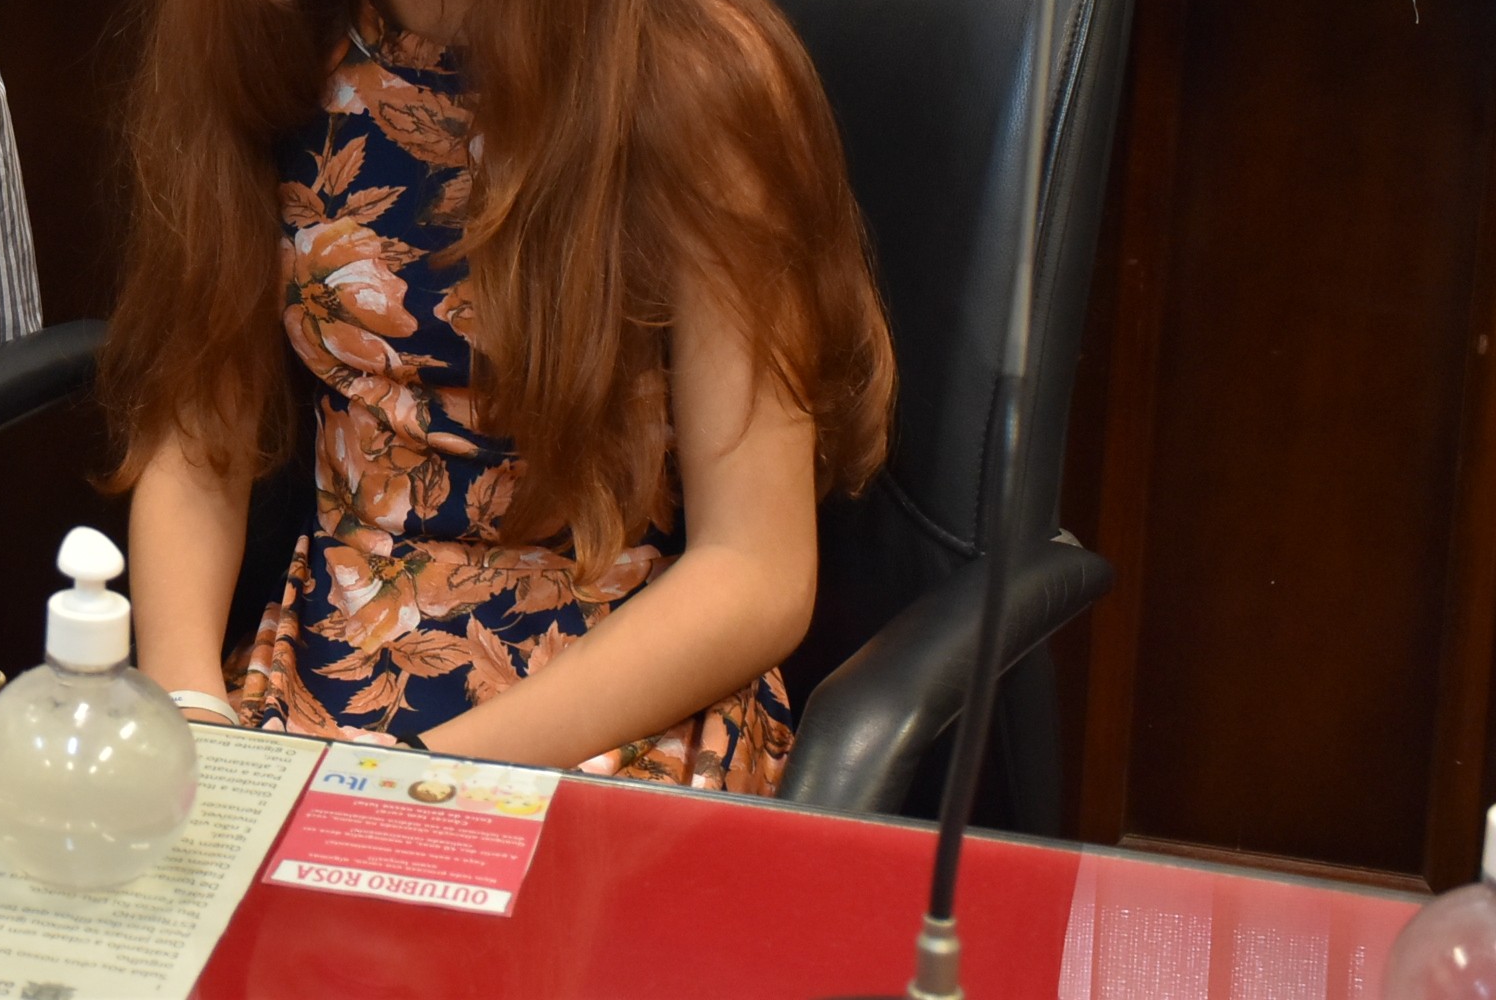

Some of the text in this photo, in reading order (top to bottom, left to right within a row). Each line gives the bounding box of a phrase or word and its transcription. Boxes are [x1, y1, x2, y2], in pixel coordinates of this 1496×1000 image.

[325, 774, 368, 792] Itu
[296, 865, 489, 906] OUTUBRO ROSA
